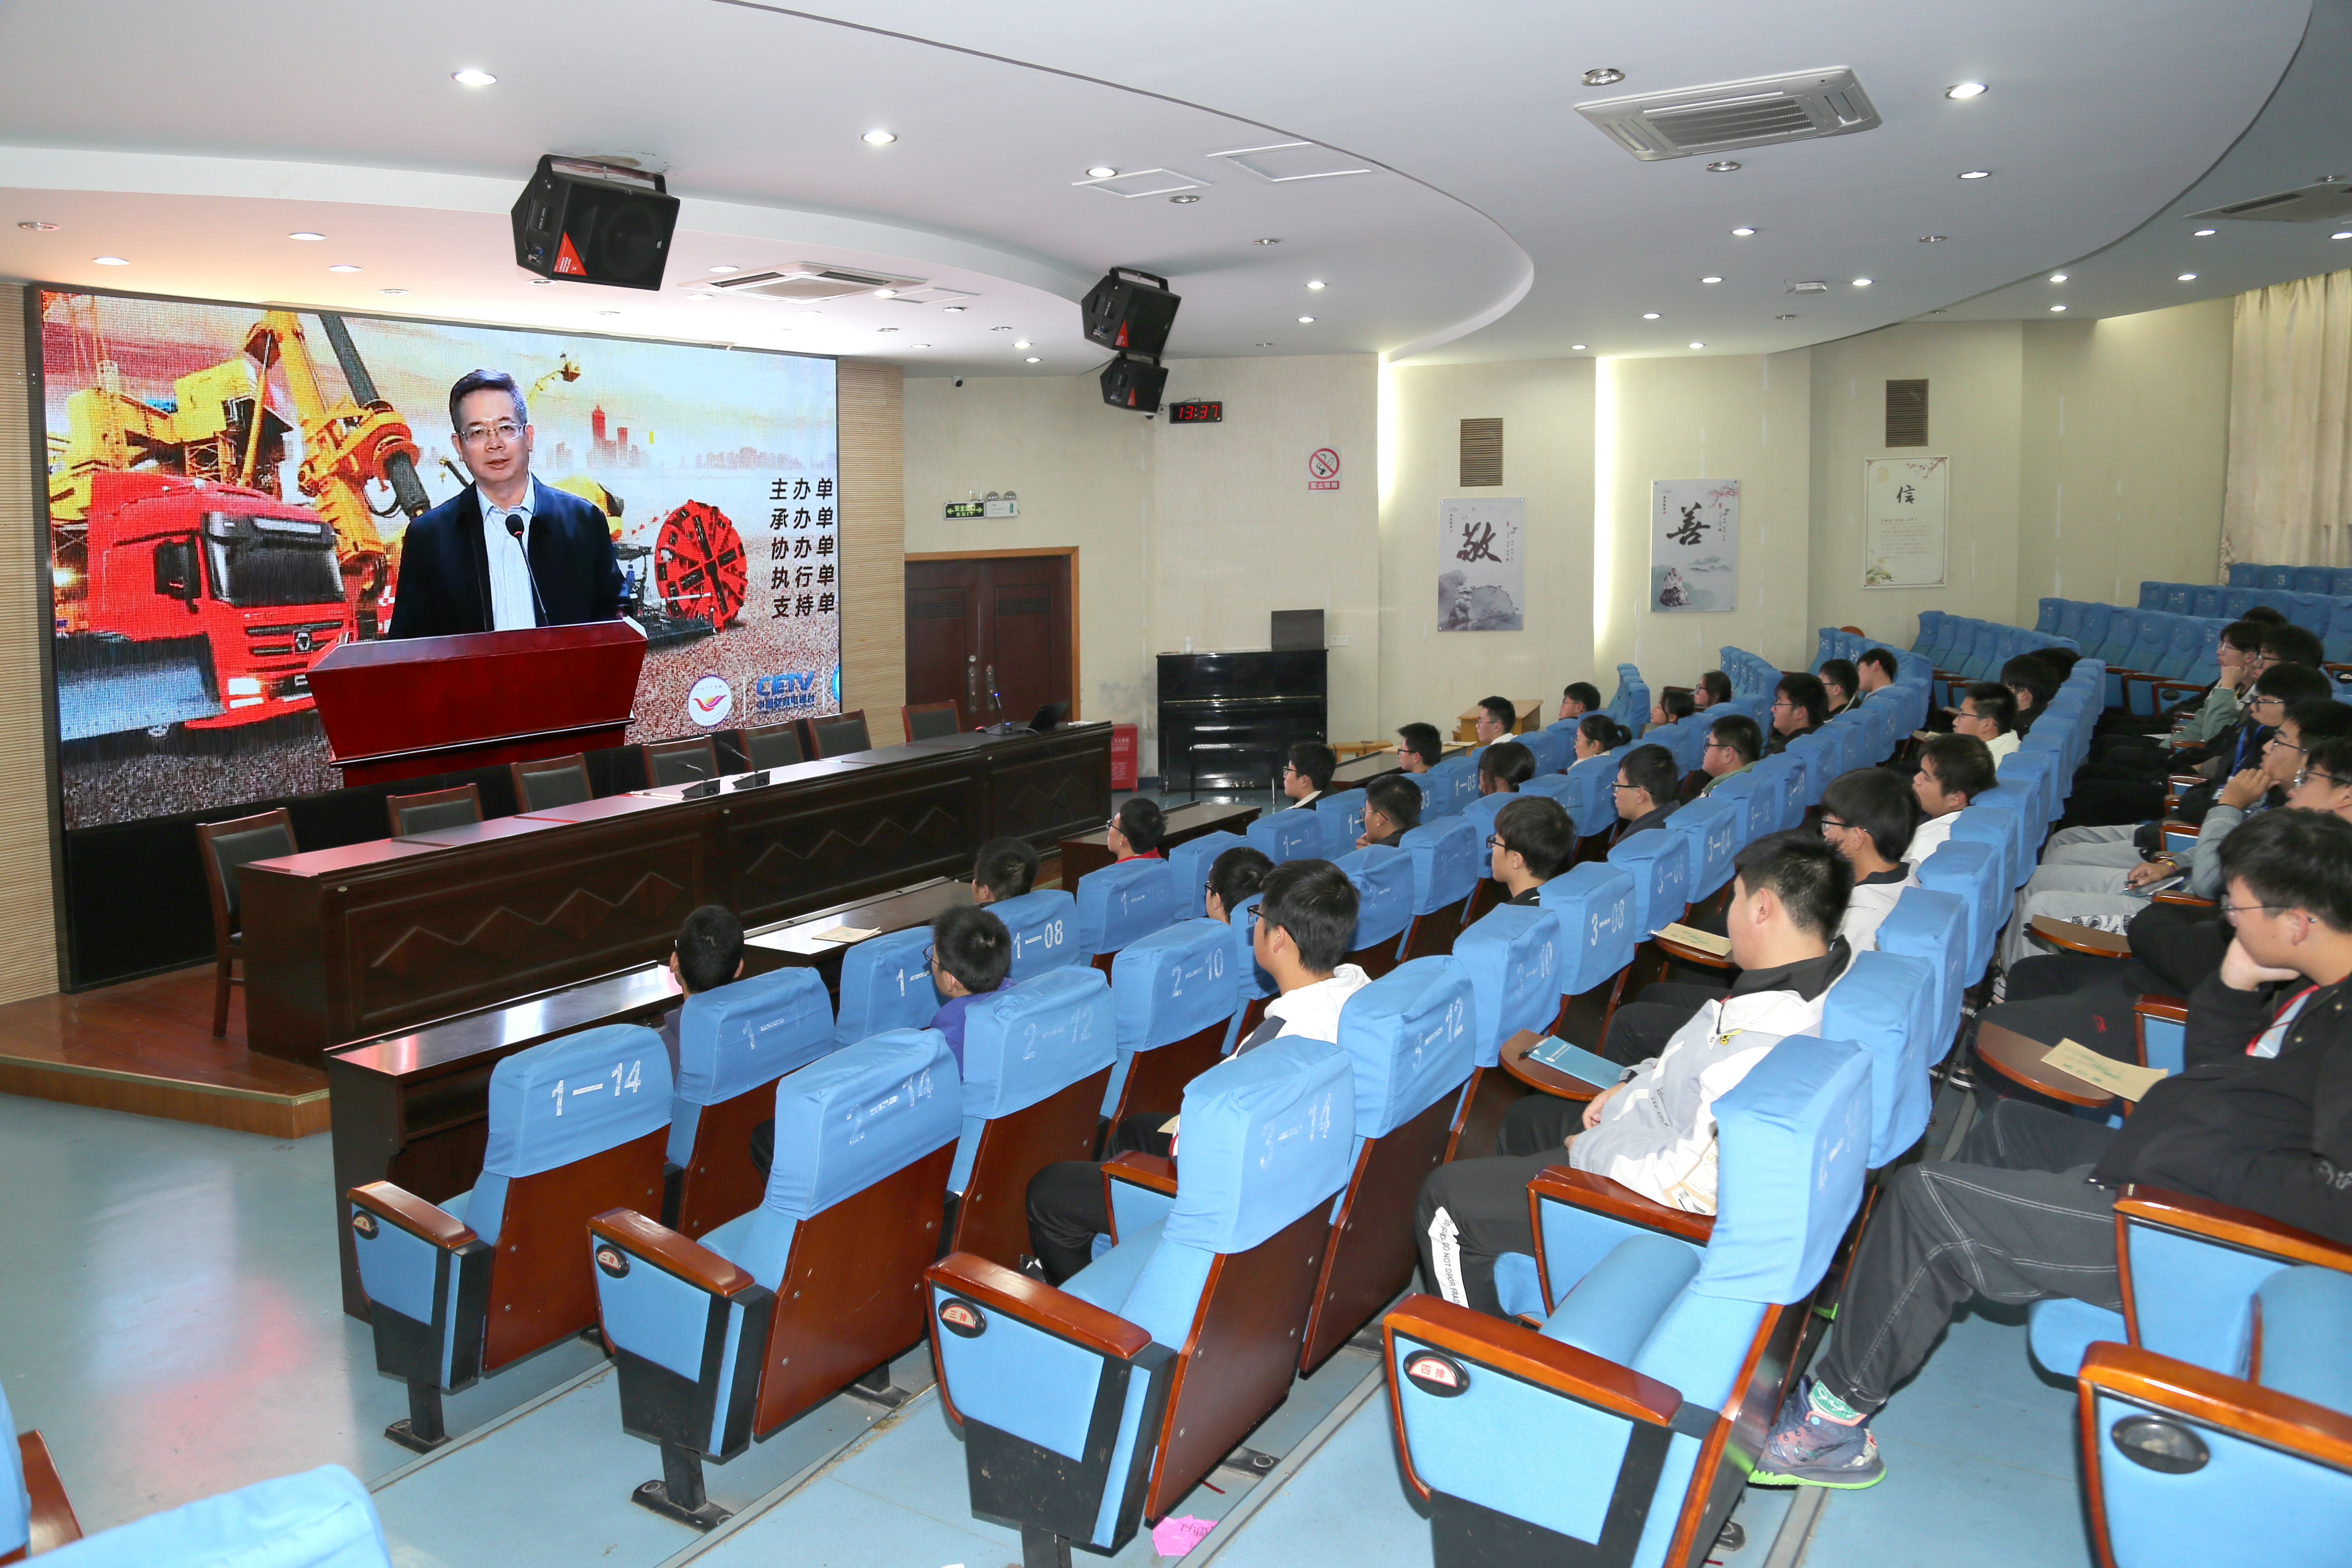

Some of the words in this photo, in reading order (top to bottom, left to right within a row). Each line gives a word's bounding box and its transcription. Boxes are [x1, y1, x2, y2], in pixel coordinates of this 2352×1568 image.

[1179, 405, 1219, 419] 13:37
[769, 478, 834, 500] 主办单
[1896, 485, 1916, 504] 信
[769, 507, 834, 530] 承办单
[1666, 502, 1711, 545] 善
[771, 535, 834, 560] 协办单
[771, 564, 834, 589] 执行单
[772, 592, 835, 618] 支持单
[757, 671, 814, 696] CETV
[1421, 790, 1430, 809] 03
[1442, 1242, 1450, 1251] GO
[601, 1254, 615, 1265] 二排
[1443, 1252, 1452, 1268] NOT
[949, 1310, 968, 1322] 三排
[1421, 1364, 1445, 1379] 四排
